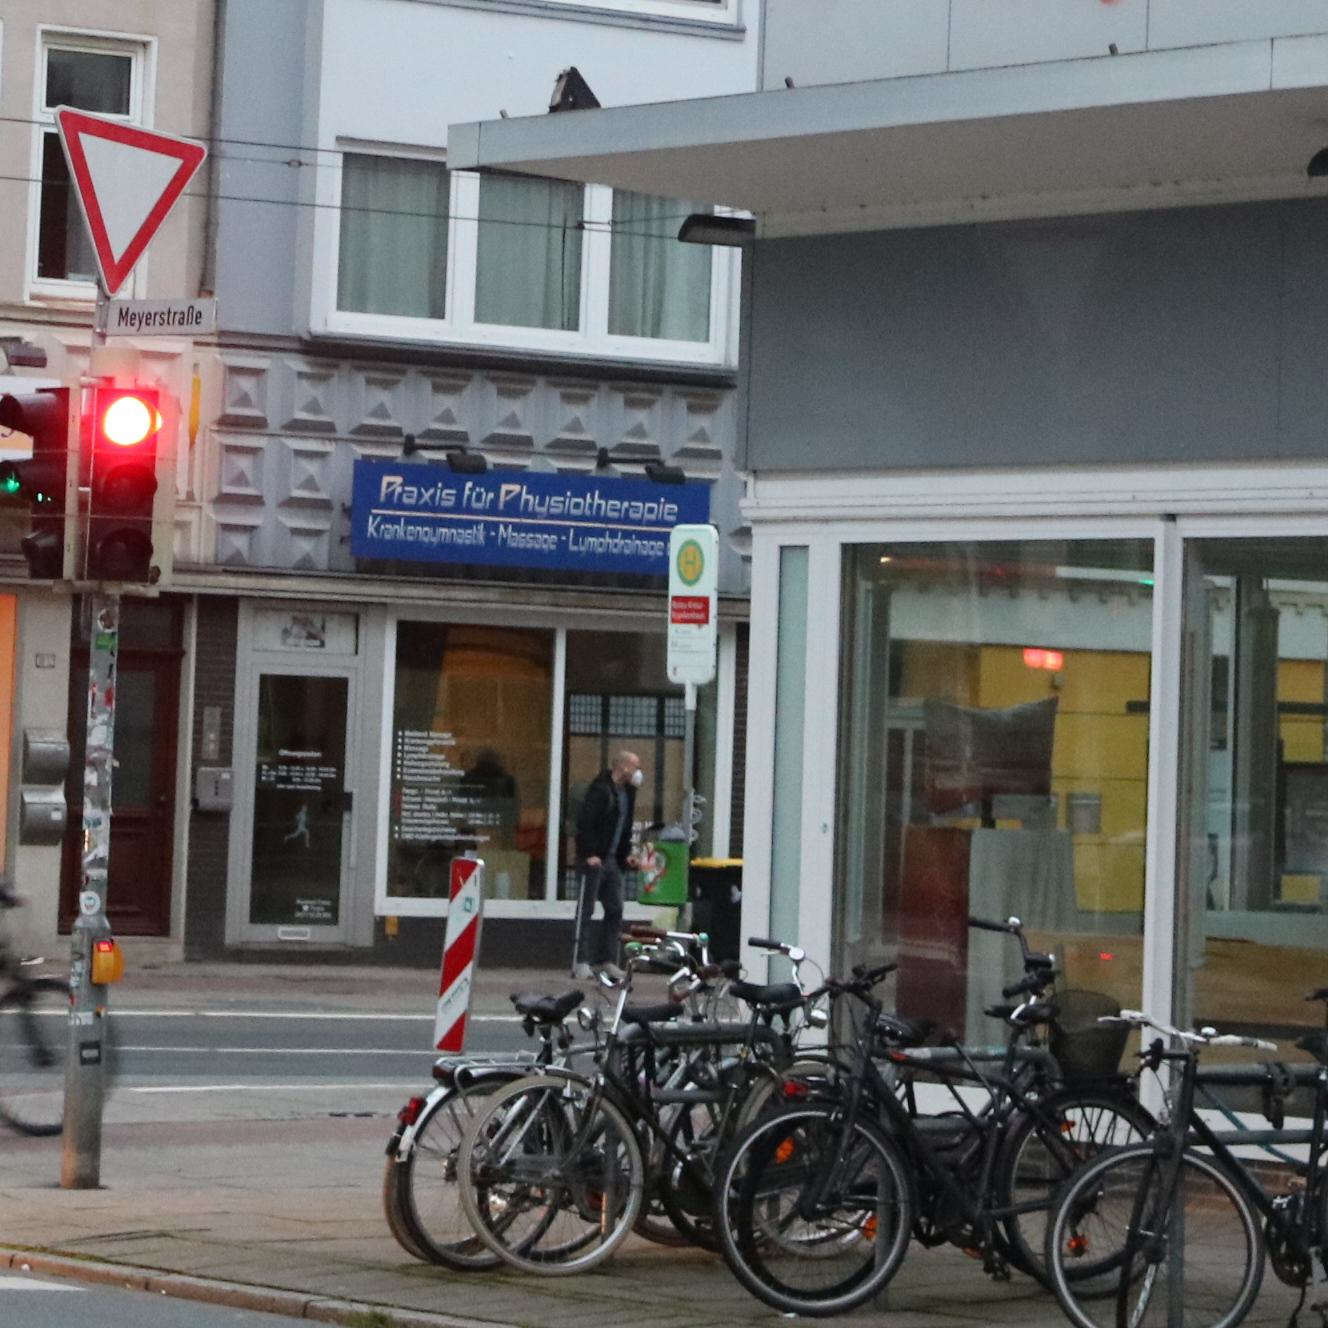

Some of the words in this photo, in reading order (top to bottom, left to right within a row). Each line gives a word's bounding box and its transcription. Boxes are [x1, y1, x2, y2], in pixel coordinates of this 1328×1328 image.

[118, 305, 203, 333] Meyerstraße
[379, 475, 456, 505] Praxis
[462, 481, 494, 510] für
[498, 484, 679, 522] Physiotherapie
[367, 515, 485, 546] Krankengymnastik
[498, 527, 558, 551] Massage
[569, 528, 665, 557] Lymphdrainage
